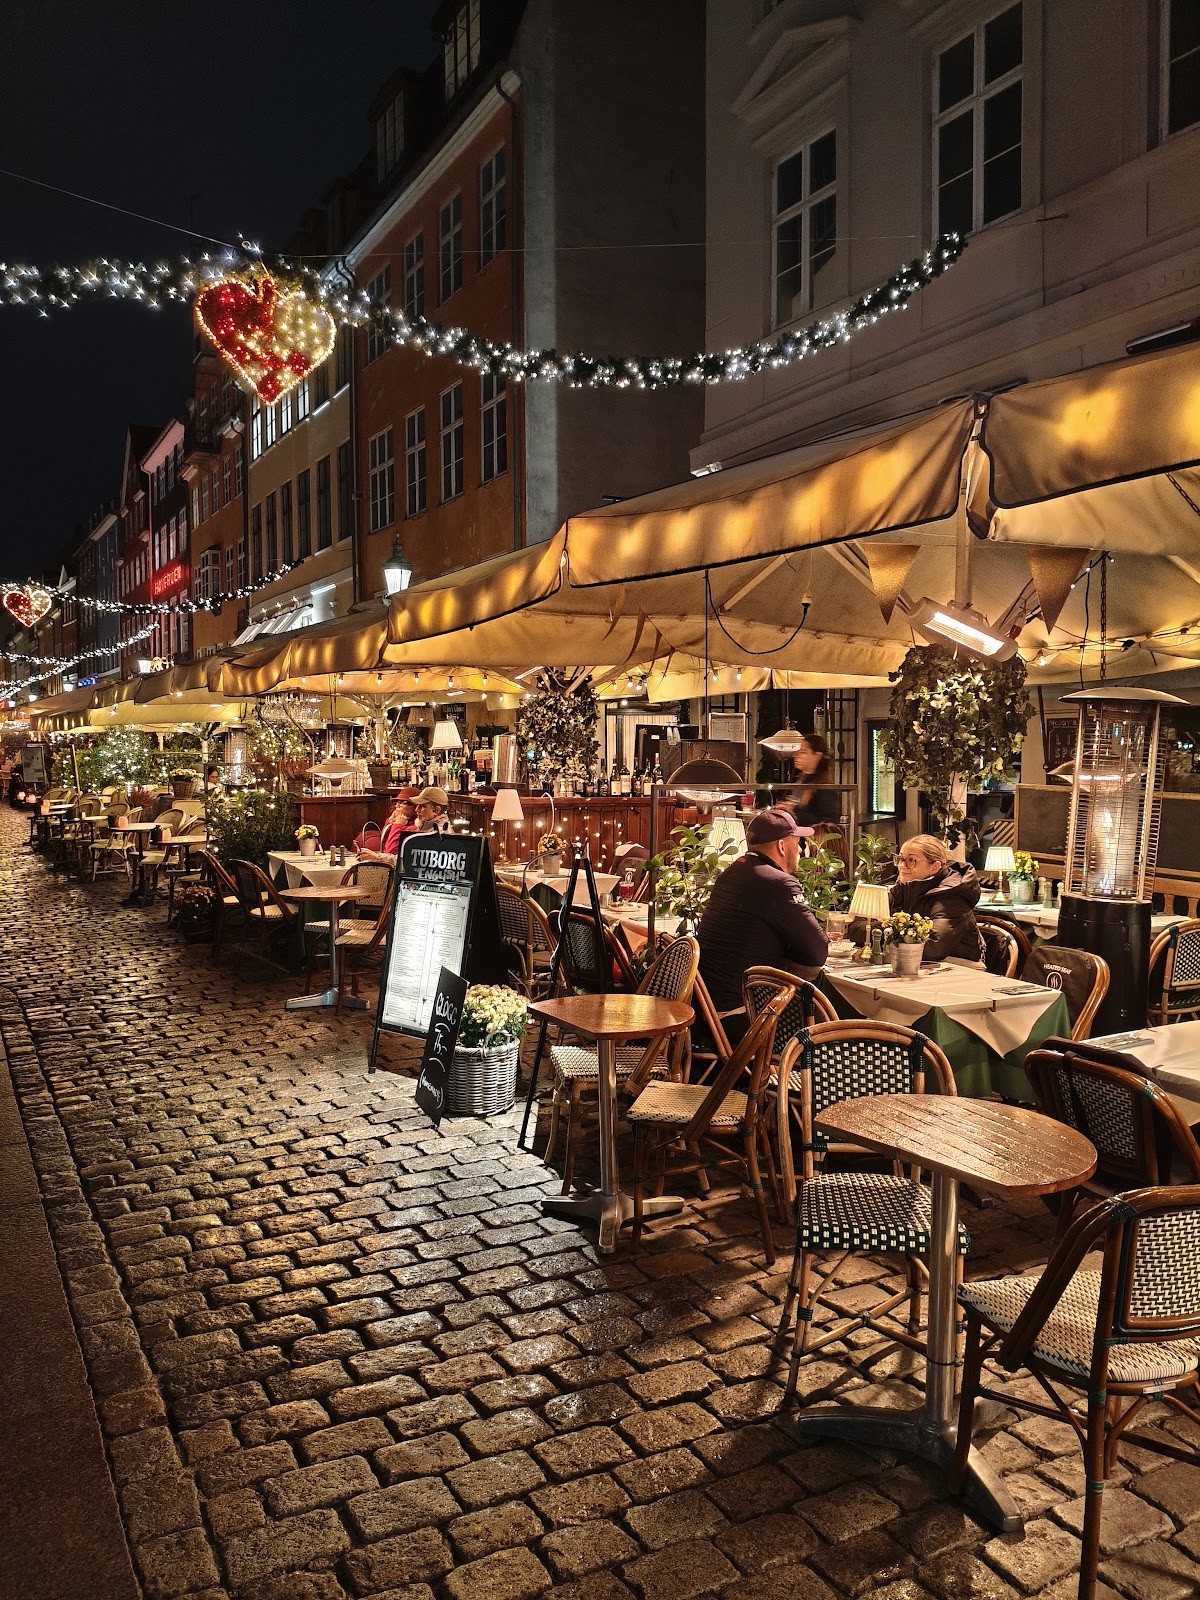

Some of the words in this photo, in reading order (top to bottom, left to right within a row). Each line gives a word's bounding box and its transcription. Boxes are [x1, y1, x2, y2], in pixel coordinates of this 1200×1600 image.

[411, 848, 466, 871] TUBORG
[1043, 963, 1061, 972] HEATED
[1061, 966, 1072, 975] SEAT
